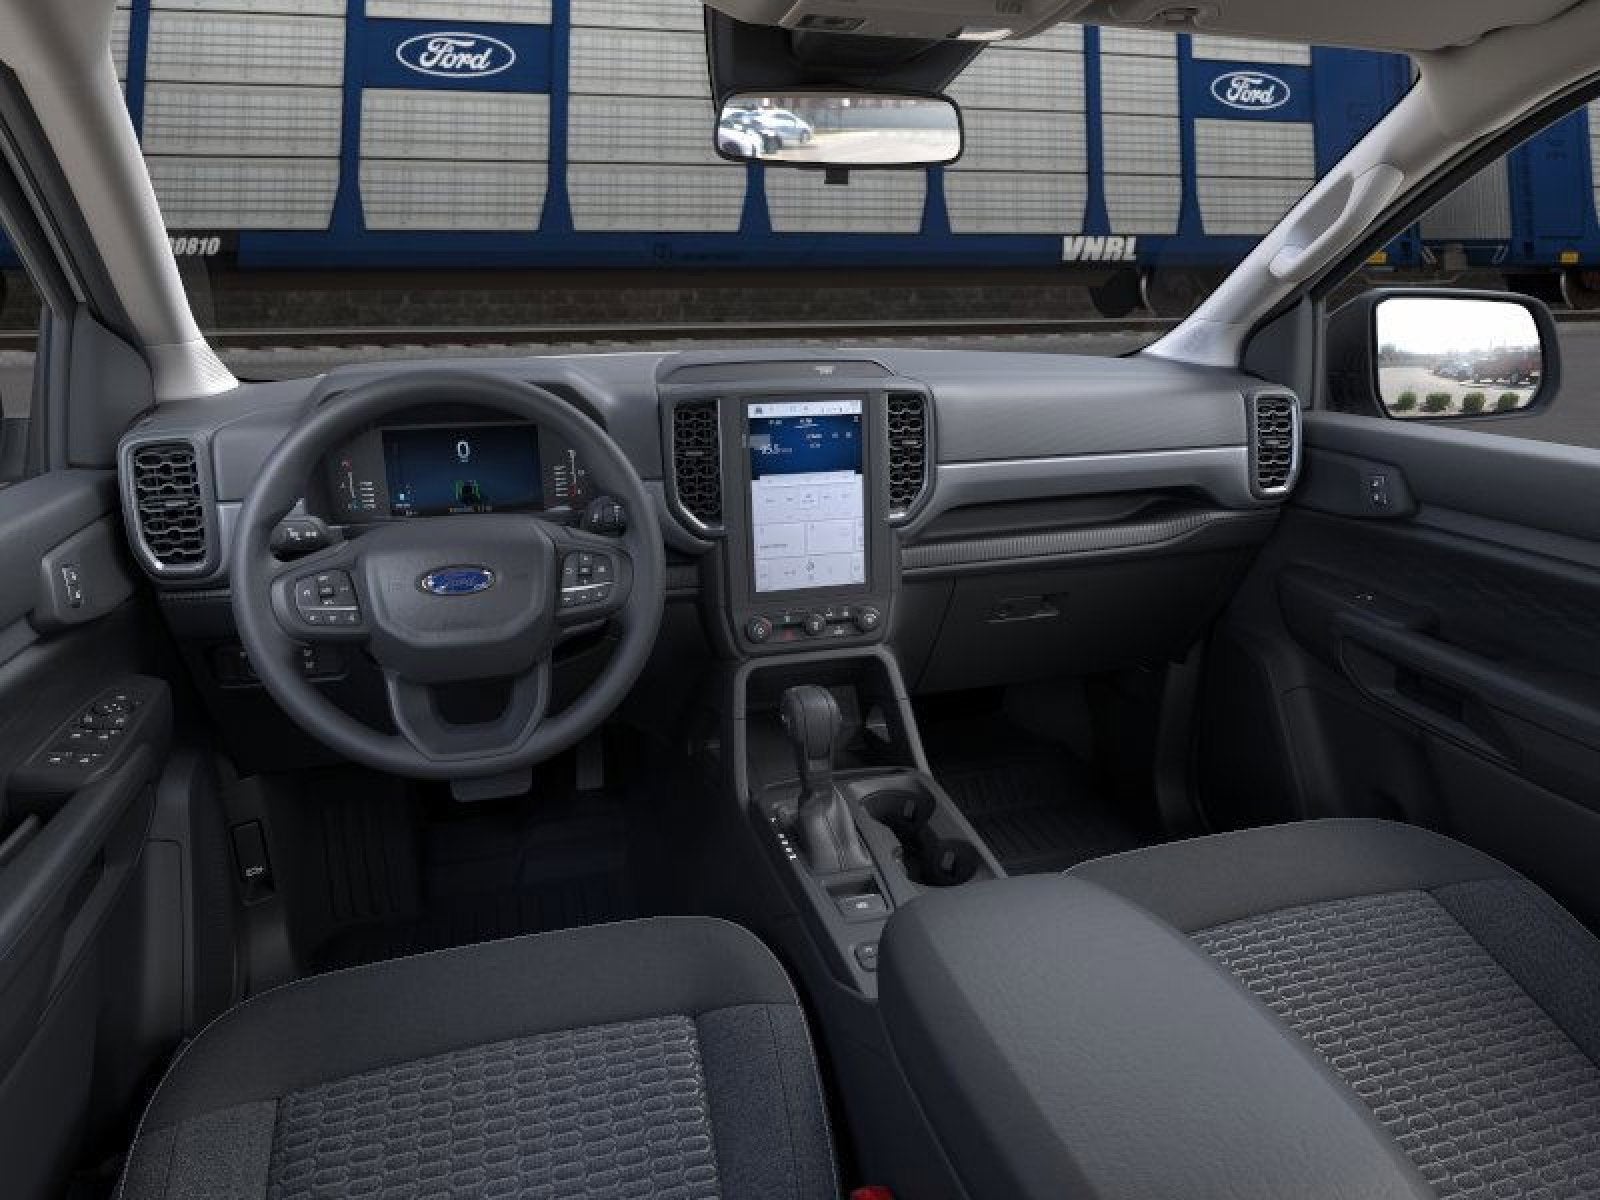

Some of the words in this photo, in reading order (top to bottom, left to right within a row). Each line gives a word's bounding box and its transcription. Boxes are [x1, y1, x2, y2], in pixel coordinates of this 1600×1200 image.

[419, 38, 493, 69] Ford
[1227, 76, 1275, 103] Ford
[1063, 235, 1137, 261] VNRL
[457, 441, 470, 459] 0
